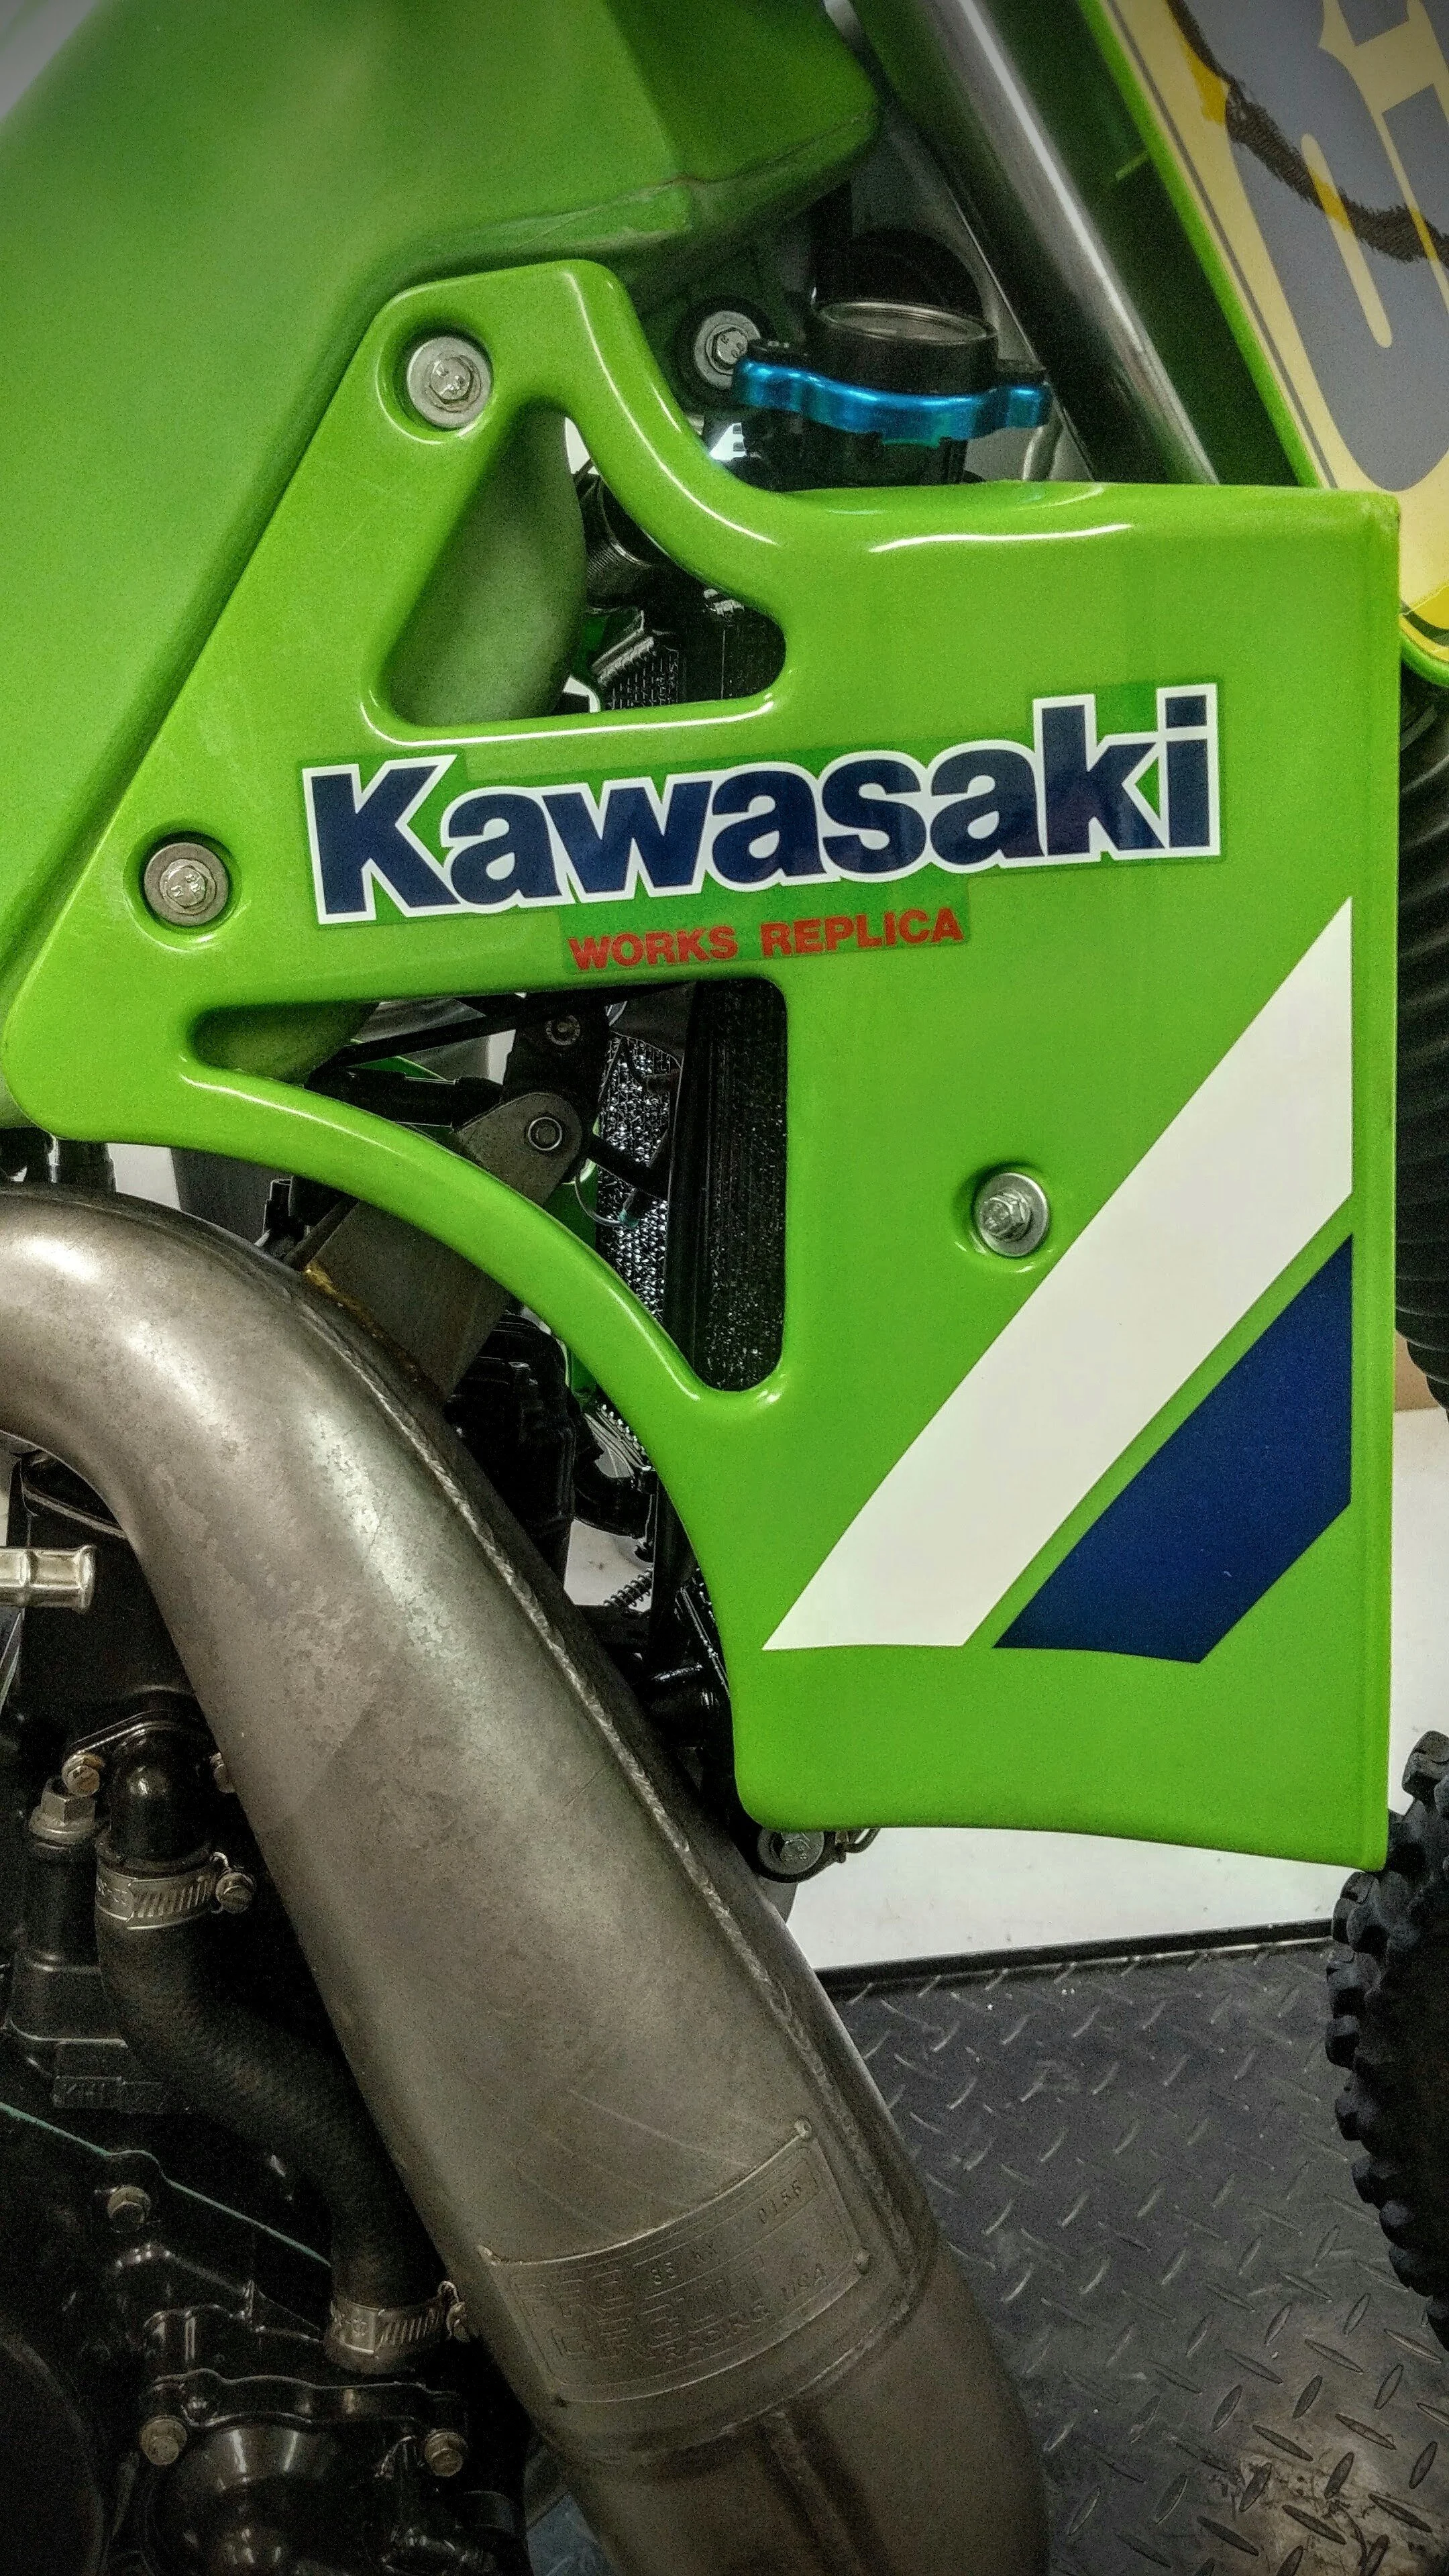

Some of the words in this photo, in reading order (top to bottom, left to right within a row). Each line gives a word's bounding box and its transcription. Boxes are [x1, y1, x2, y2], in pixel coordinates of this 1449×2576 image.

[305, 685, 1218, 924] Kawasaki
[569, 925, 738, 971] WORKS
[759, 907, 965, 959] REPLICA
